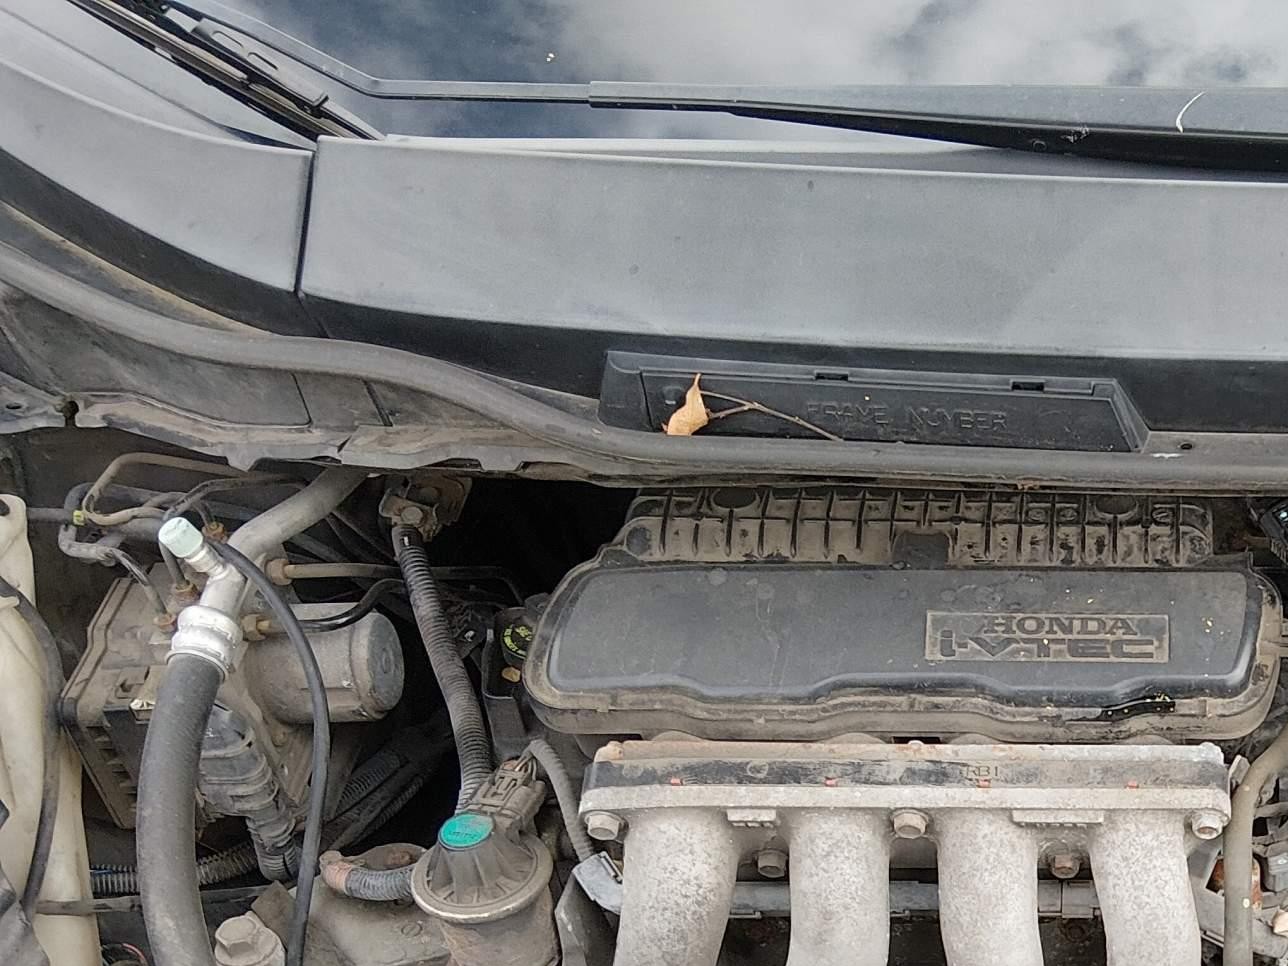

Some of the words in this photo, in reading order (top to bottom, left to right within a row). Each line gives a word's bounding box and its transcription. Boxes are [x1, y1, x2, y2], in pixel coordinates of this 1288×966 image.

[808, 402, 889, 425] FRAME
[906, 405, 1008, 431] NUMBER
[983, 616, 1138, 636] HONDA
[940, 629, 1154, 659] i-VTEC
